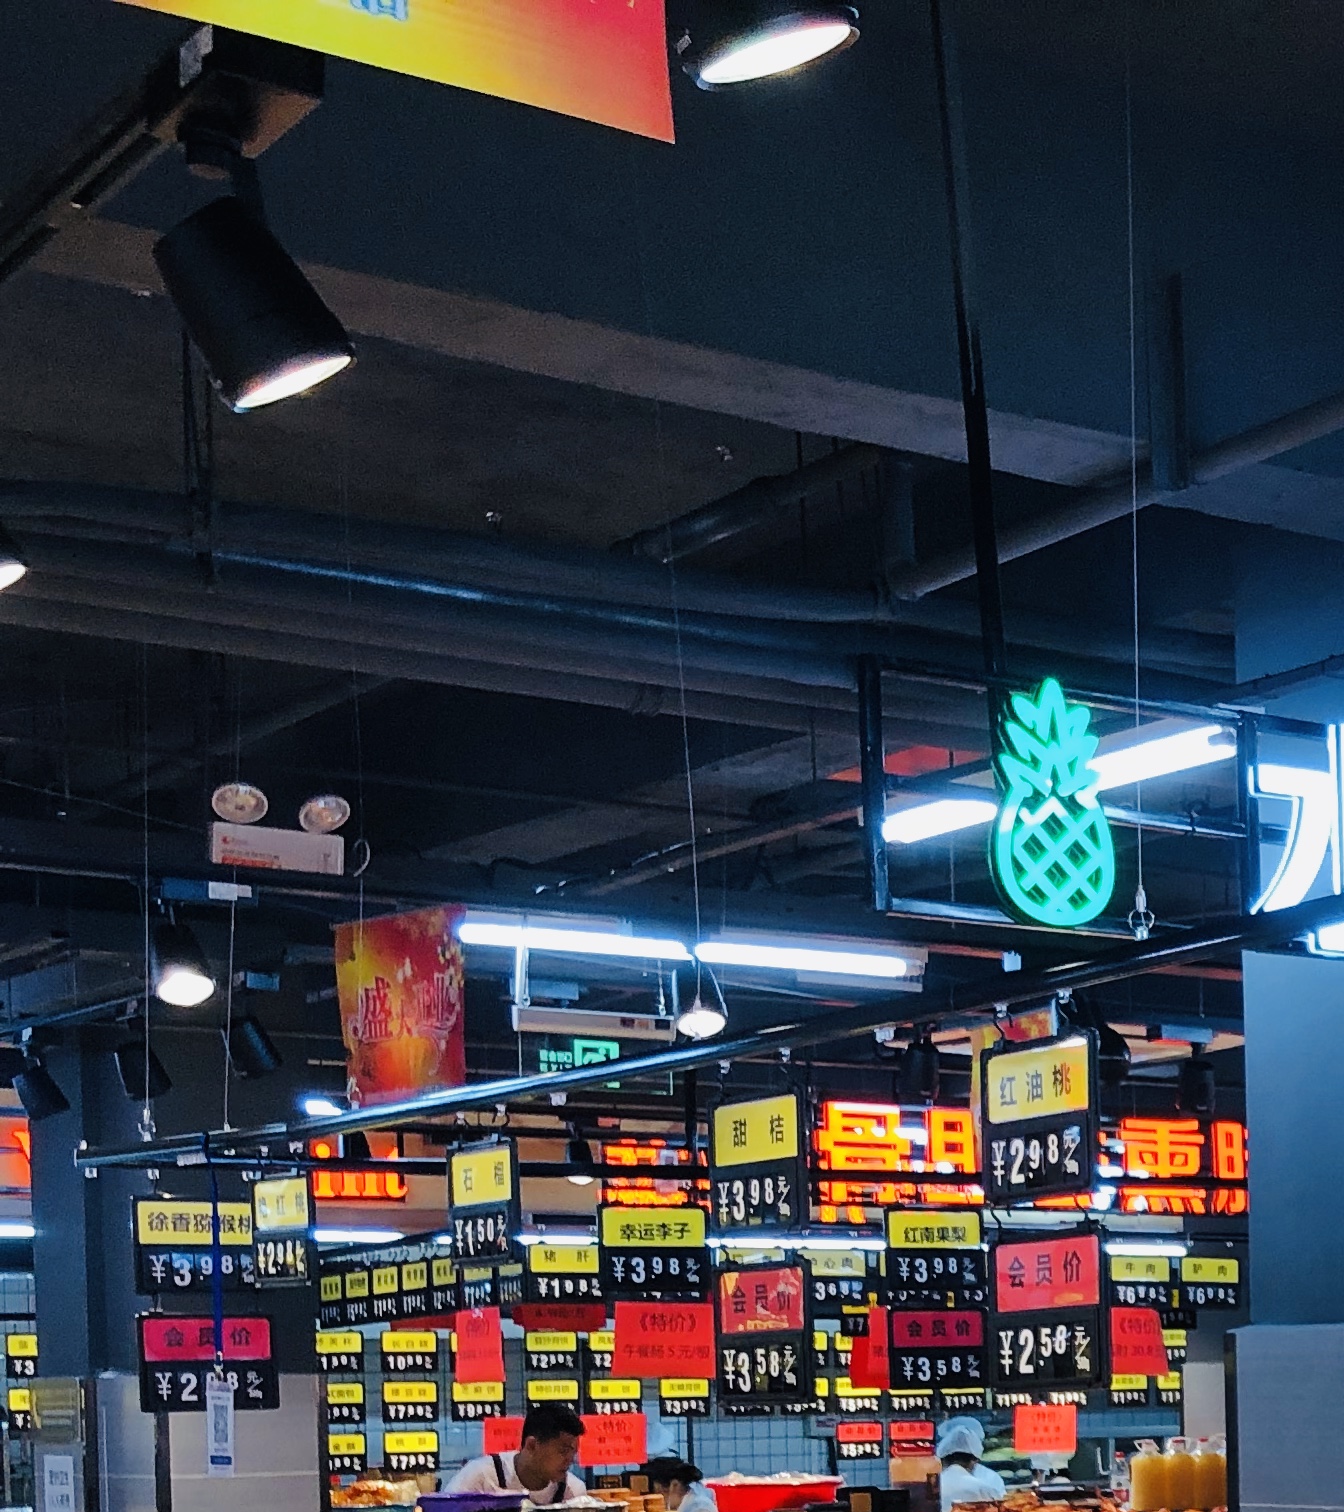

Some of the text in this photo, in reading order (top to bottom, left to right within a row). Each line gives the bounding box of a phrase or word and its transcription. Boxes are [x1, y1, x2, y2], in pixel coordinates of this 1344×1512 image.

[999, 1062, 1072, 1108] 红油桃
[732, 1113, 785, 1148] 甜桔
[991, 1133, 1059, 1187] ¥2.98
[462, 1165, 506, 1194] 石榴
[717, 1177, 775, 1224] ¥3.98
[619, 1223, 692, 1242] 幸运李子
[903, 1227, 967, 1245] 红南果梨
[149, 1252, 234, 1287] ¥3.98
[611, 1255, 681, 1284] ¥3.98
[897, 1256, 958, 1283] ¥3.98
[1008, 1249, 1083, 1288] 会员价
[732, 1282, 792, 1316] 会员价
[163, 1326, 252, 1348] 会员价
[906, 1319, 971, 1338] 会员价
[998, 1324, 1068, 1377] ¥2.58
[723, 1349, 780, 1393] ¥3.58
[901, 1356, 962, 1382] ¥3.58
